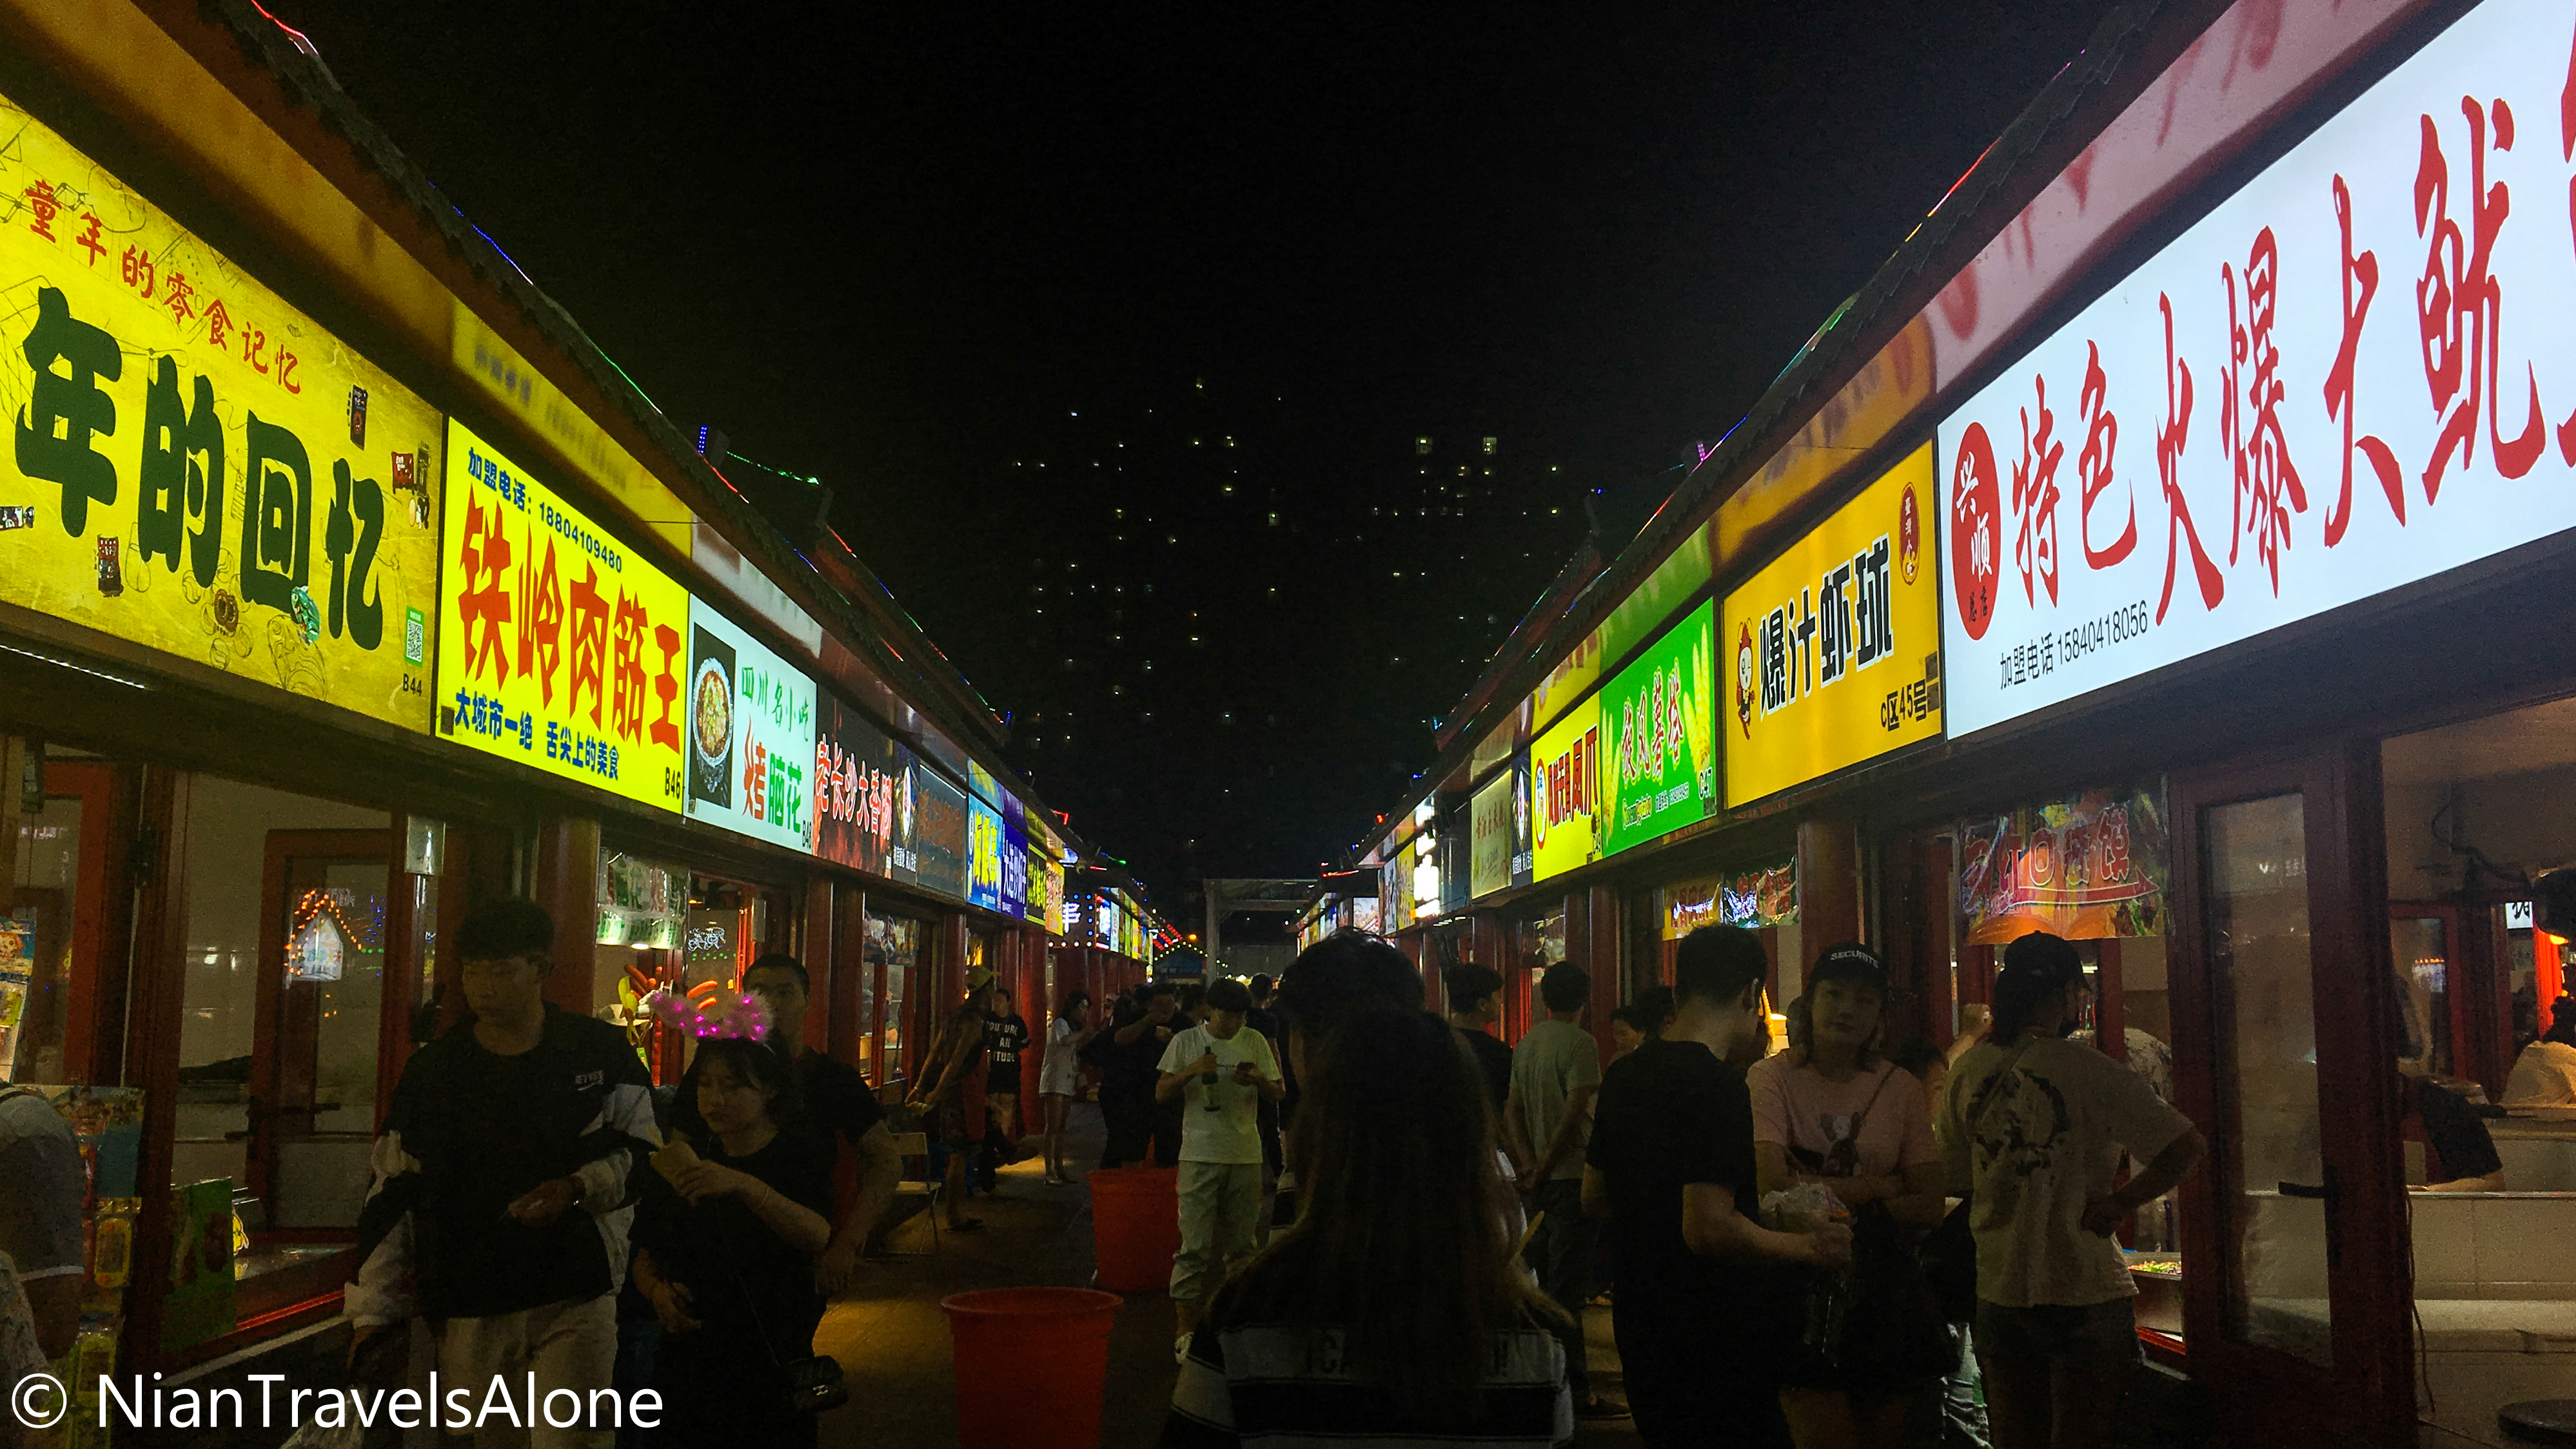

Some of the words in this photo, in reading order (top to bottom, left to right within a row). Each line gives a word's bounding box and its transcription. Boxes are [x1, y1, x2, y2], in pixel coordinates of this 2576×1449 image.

[26, 179, 301, 394] 童年的零食记忆
[2012, 13, 2576, 626] 特色火爆大鱿
[15, 286, 384, 651] 年的回忆
[1956, 451, 1993, 582] 兴顺
[539, 501, 622, 574] 18804109480
[458, 482, 682, 755] 铁岭肉筋王
[1758, 532, 1893, 722] 爆汁虾球
[2000, 631, 2055, 691] 加盟电话
[2057, 599, 2148, 666] 15840418056
[402, 673, 423, 697] B44
[454, 686, 533, 751] 大城市一绝
[546, 721, 620, 782] 舌尖上的美食
[742, 666, 809, 743] 四川名小吃
[665, 766, 681, 800] B46
[742, 713, 803, 834] 烤脑花
[1698, 766, 1714, 801] C47
